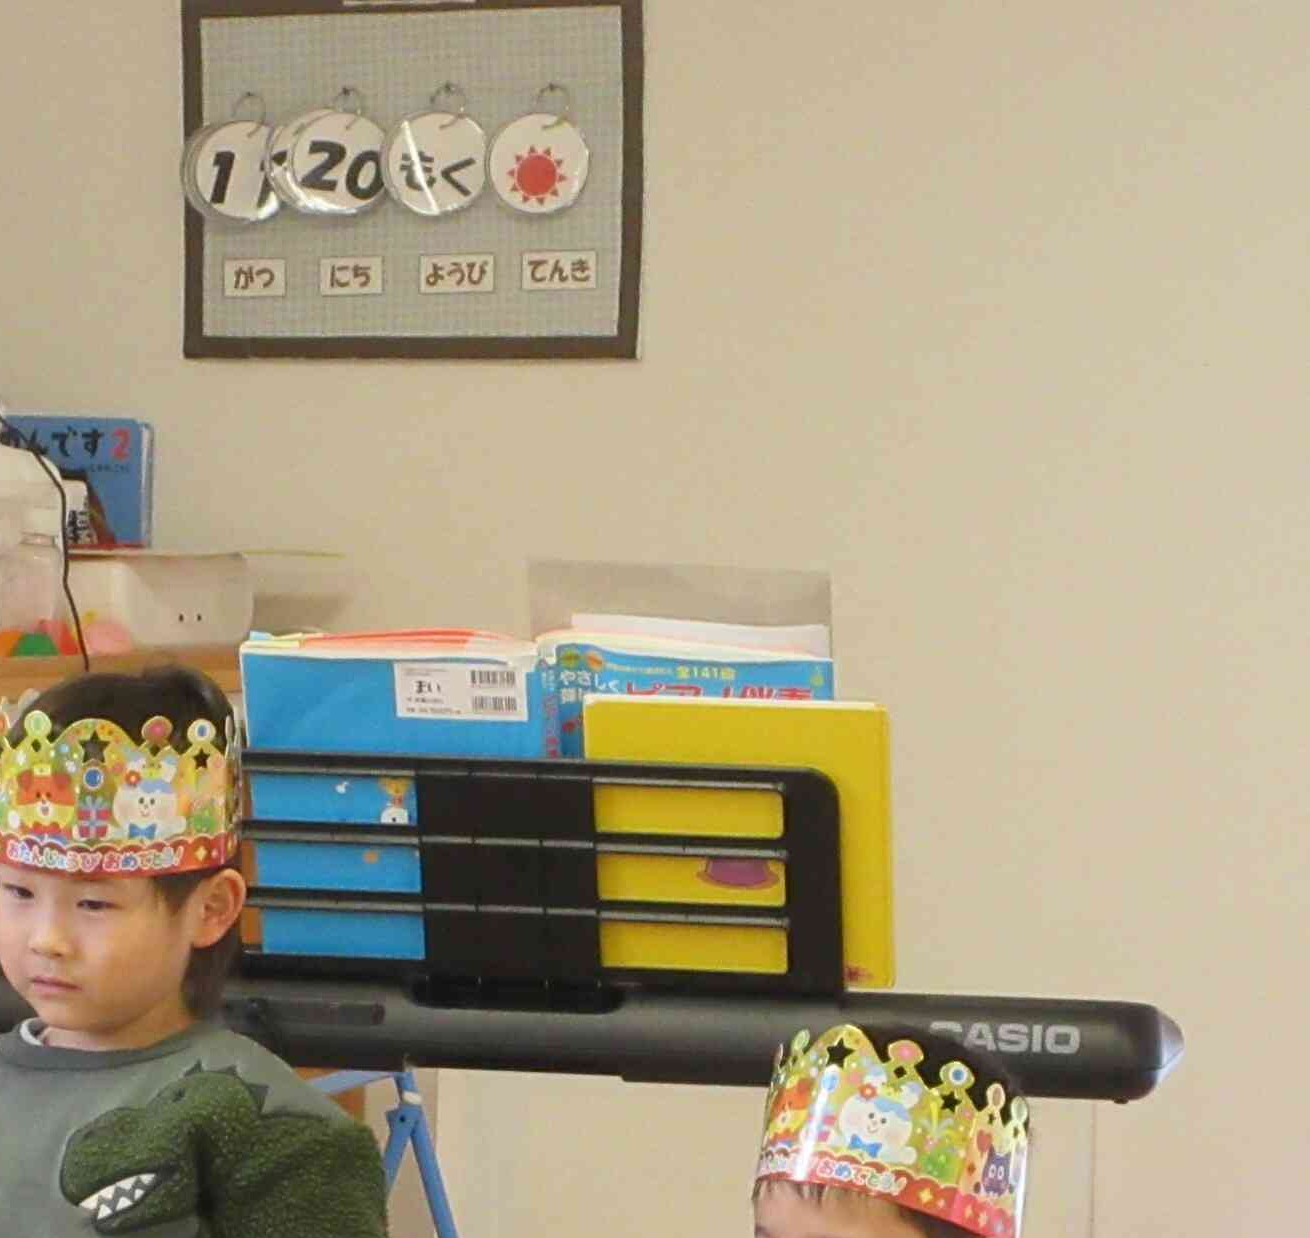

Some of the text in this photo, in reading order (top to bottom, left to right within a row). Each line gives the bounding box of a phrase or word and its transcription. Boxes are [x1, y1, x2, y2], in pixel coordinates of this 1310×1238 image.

[301, 140, 384, 200] 20
[400, 150, 476, 197] もく
[233, 264, 275, 290] がつ
[329, 264, 371, 288] にち
[425, 261, 488, 287] ようび
[528, 258, 591, 283] てんき
[559, 671, 620, 692] やさしく
